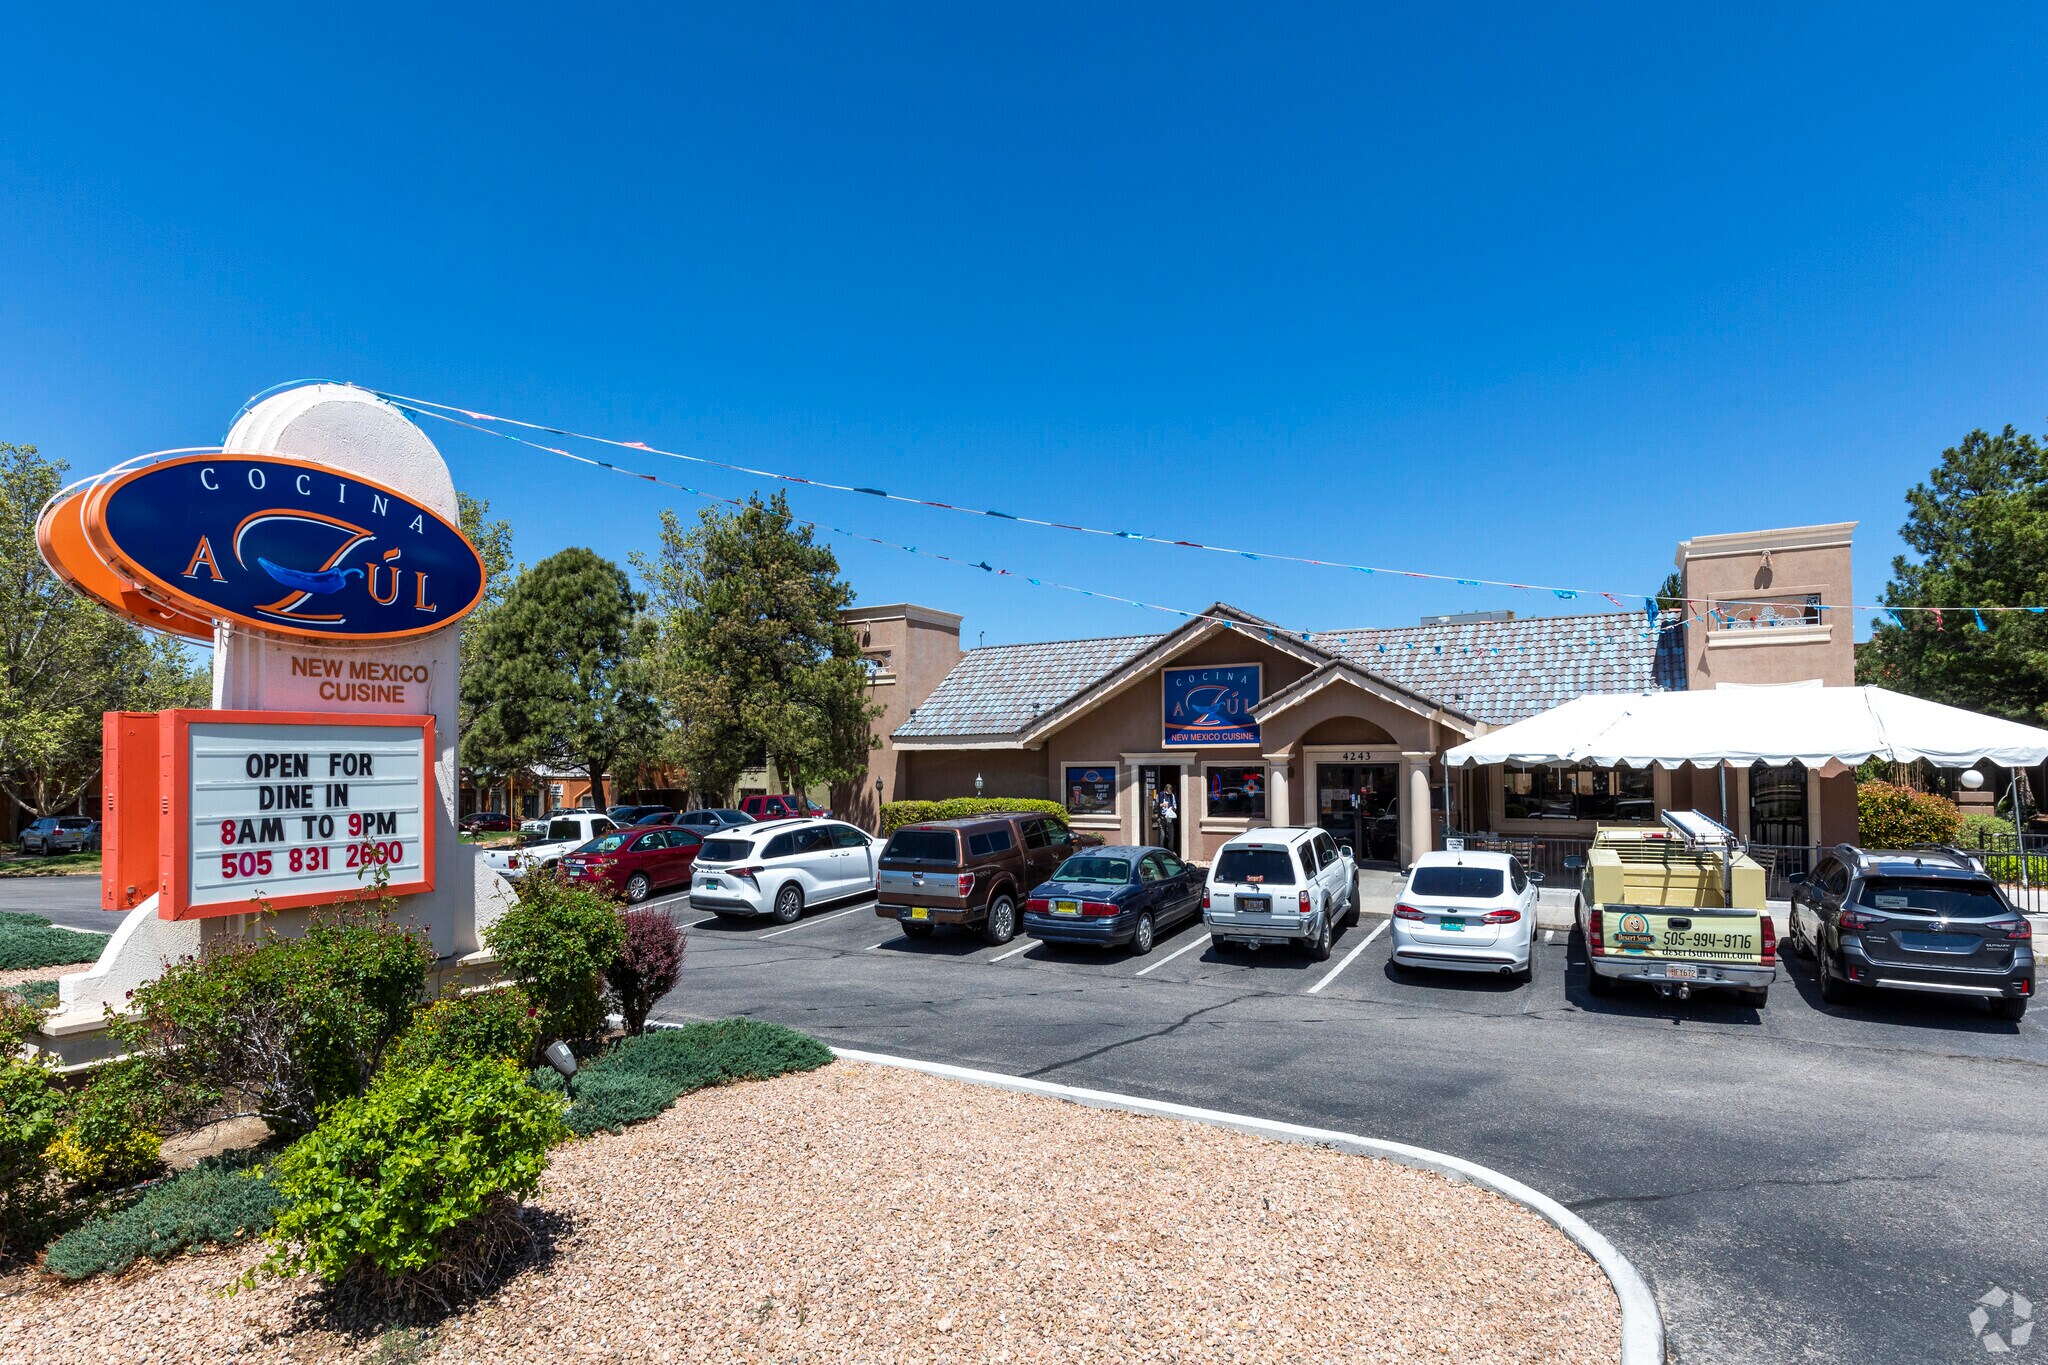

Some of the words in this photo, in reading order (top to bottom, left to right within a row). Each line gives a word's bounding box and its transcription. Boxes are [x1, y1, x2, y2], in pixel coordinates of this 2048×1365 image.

[200, 468, 424, 535] COCINA
[291, 656, 343, 678] NEW
[349, 661, 429, 683] MEXICO
[1176, 671, 1247, 687] COCINA
[319, 681, 405, 703] CUISINE
[1171, 733, 1188, 742] NEW
[1190, 732, 1220, 741] MEXICO
[1222, 732, 1254, 740] CUISINE
[246, 753, 309, 779] OPEN
[329, 753, 373, 776] FOR
[1342, 751, 1371, 761] 4243
[259, 785, 314, 810] DINE
[326, 783, 348, 807] IN
[221, 817, 285, 845] 8AM
[302, 814, 334, 839] TO
[348, 811, 397, 837] 9PM
[222, 850, 272, 879] 505
[289, 846, 329, 872] 831
[346, 840, 403, 868] 2600
[1618, 933, 1636, 941] Desert
[1637, 934, 1651, 942] Suns
[1663, 932, 1752, 949] 505-994-9176
[1662, 946, 1753, 960] desertsunsnm.com
